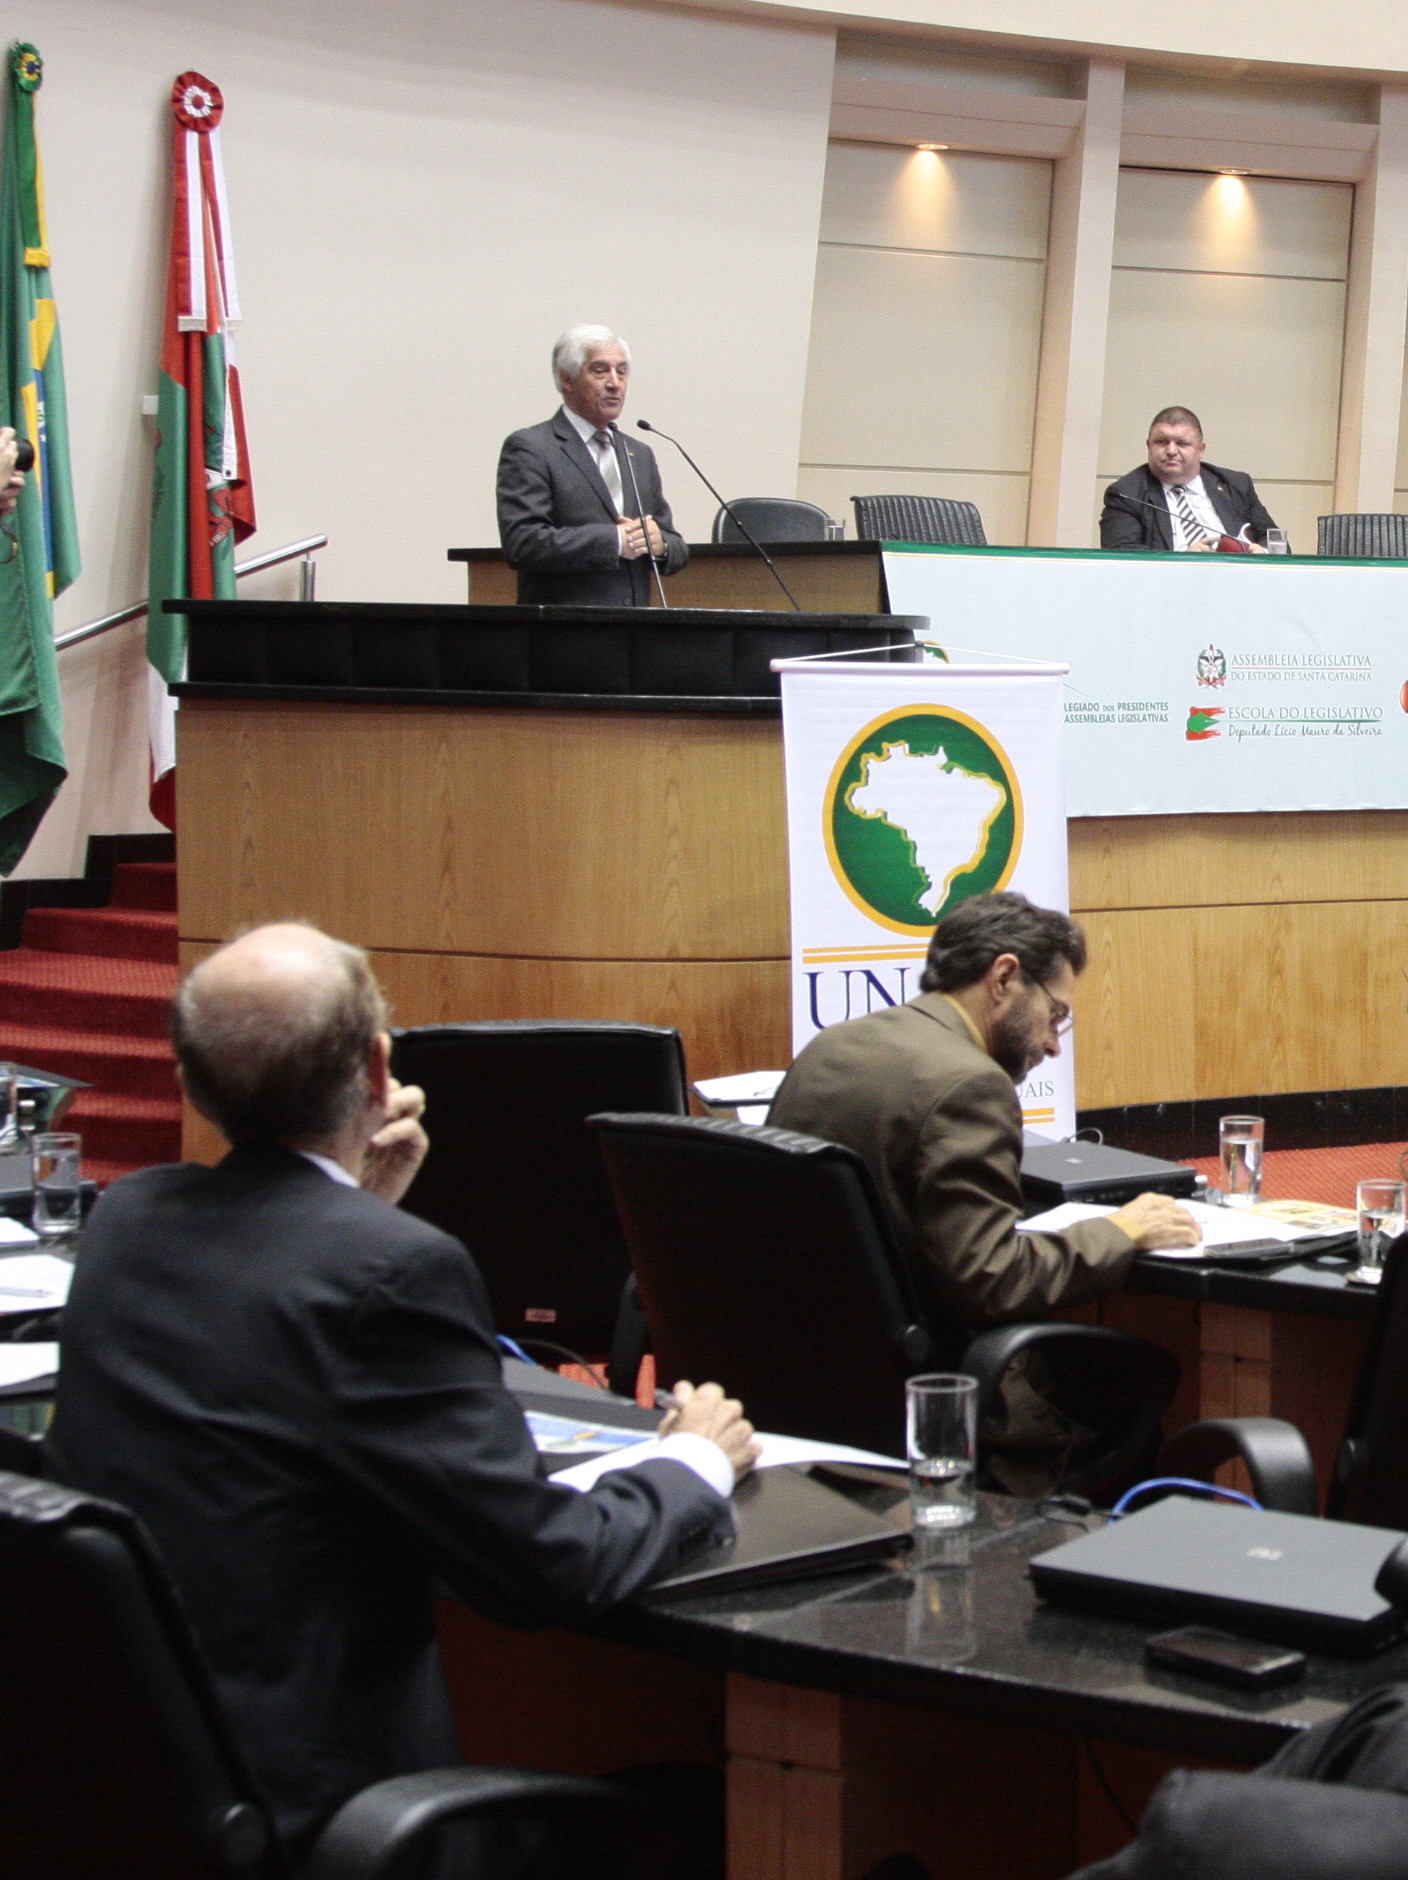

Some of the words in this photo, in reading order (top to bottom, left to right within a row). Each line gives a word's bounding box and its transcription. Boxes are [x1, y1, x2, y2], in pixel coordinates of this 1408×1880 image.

[1231, 654, 1298, 666] ASSEMBLEIA
[1302, 655, 1372, 667] LEGISLATIVA
[1231, 672, 1244, 681] DO
[1248, 672, 1282, 681] ESTADO
[1284, 672, 1296, 681] DE
[1298, 672, 1326, 682] SANTA
[1328, 672, 1372, 682] CATARINA
[1064, 702, 1100, 712] LEGIADO
[1117, 702, 1169, 711] PRESIDENTES
[1064, 714, 1115, 723] ASSEMBLEIAS
[1118, 713, 1168, 723] LEGISLATIVAS
[1228, 707, 1276, 719] ESCOLA
[1280, 707, 1299, 719] DO
[1304, 707, 1383, 720] LEGISLATIVO
[1228, 724, 1271, 743] Deputado
[1300, 725, 1330, 736] Mauro
[1333, 724, 1344, 736] da
[1347, 724, 1382, 736] Silveira
